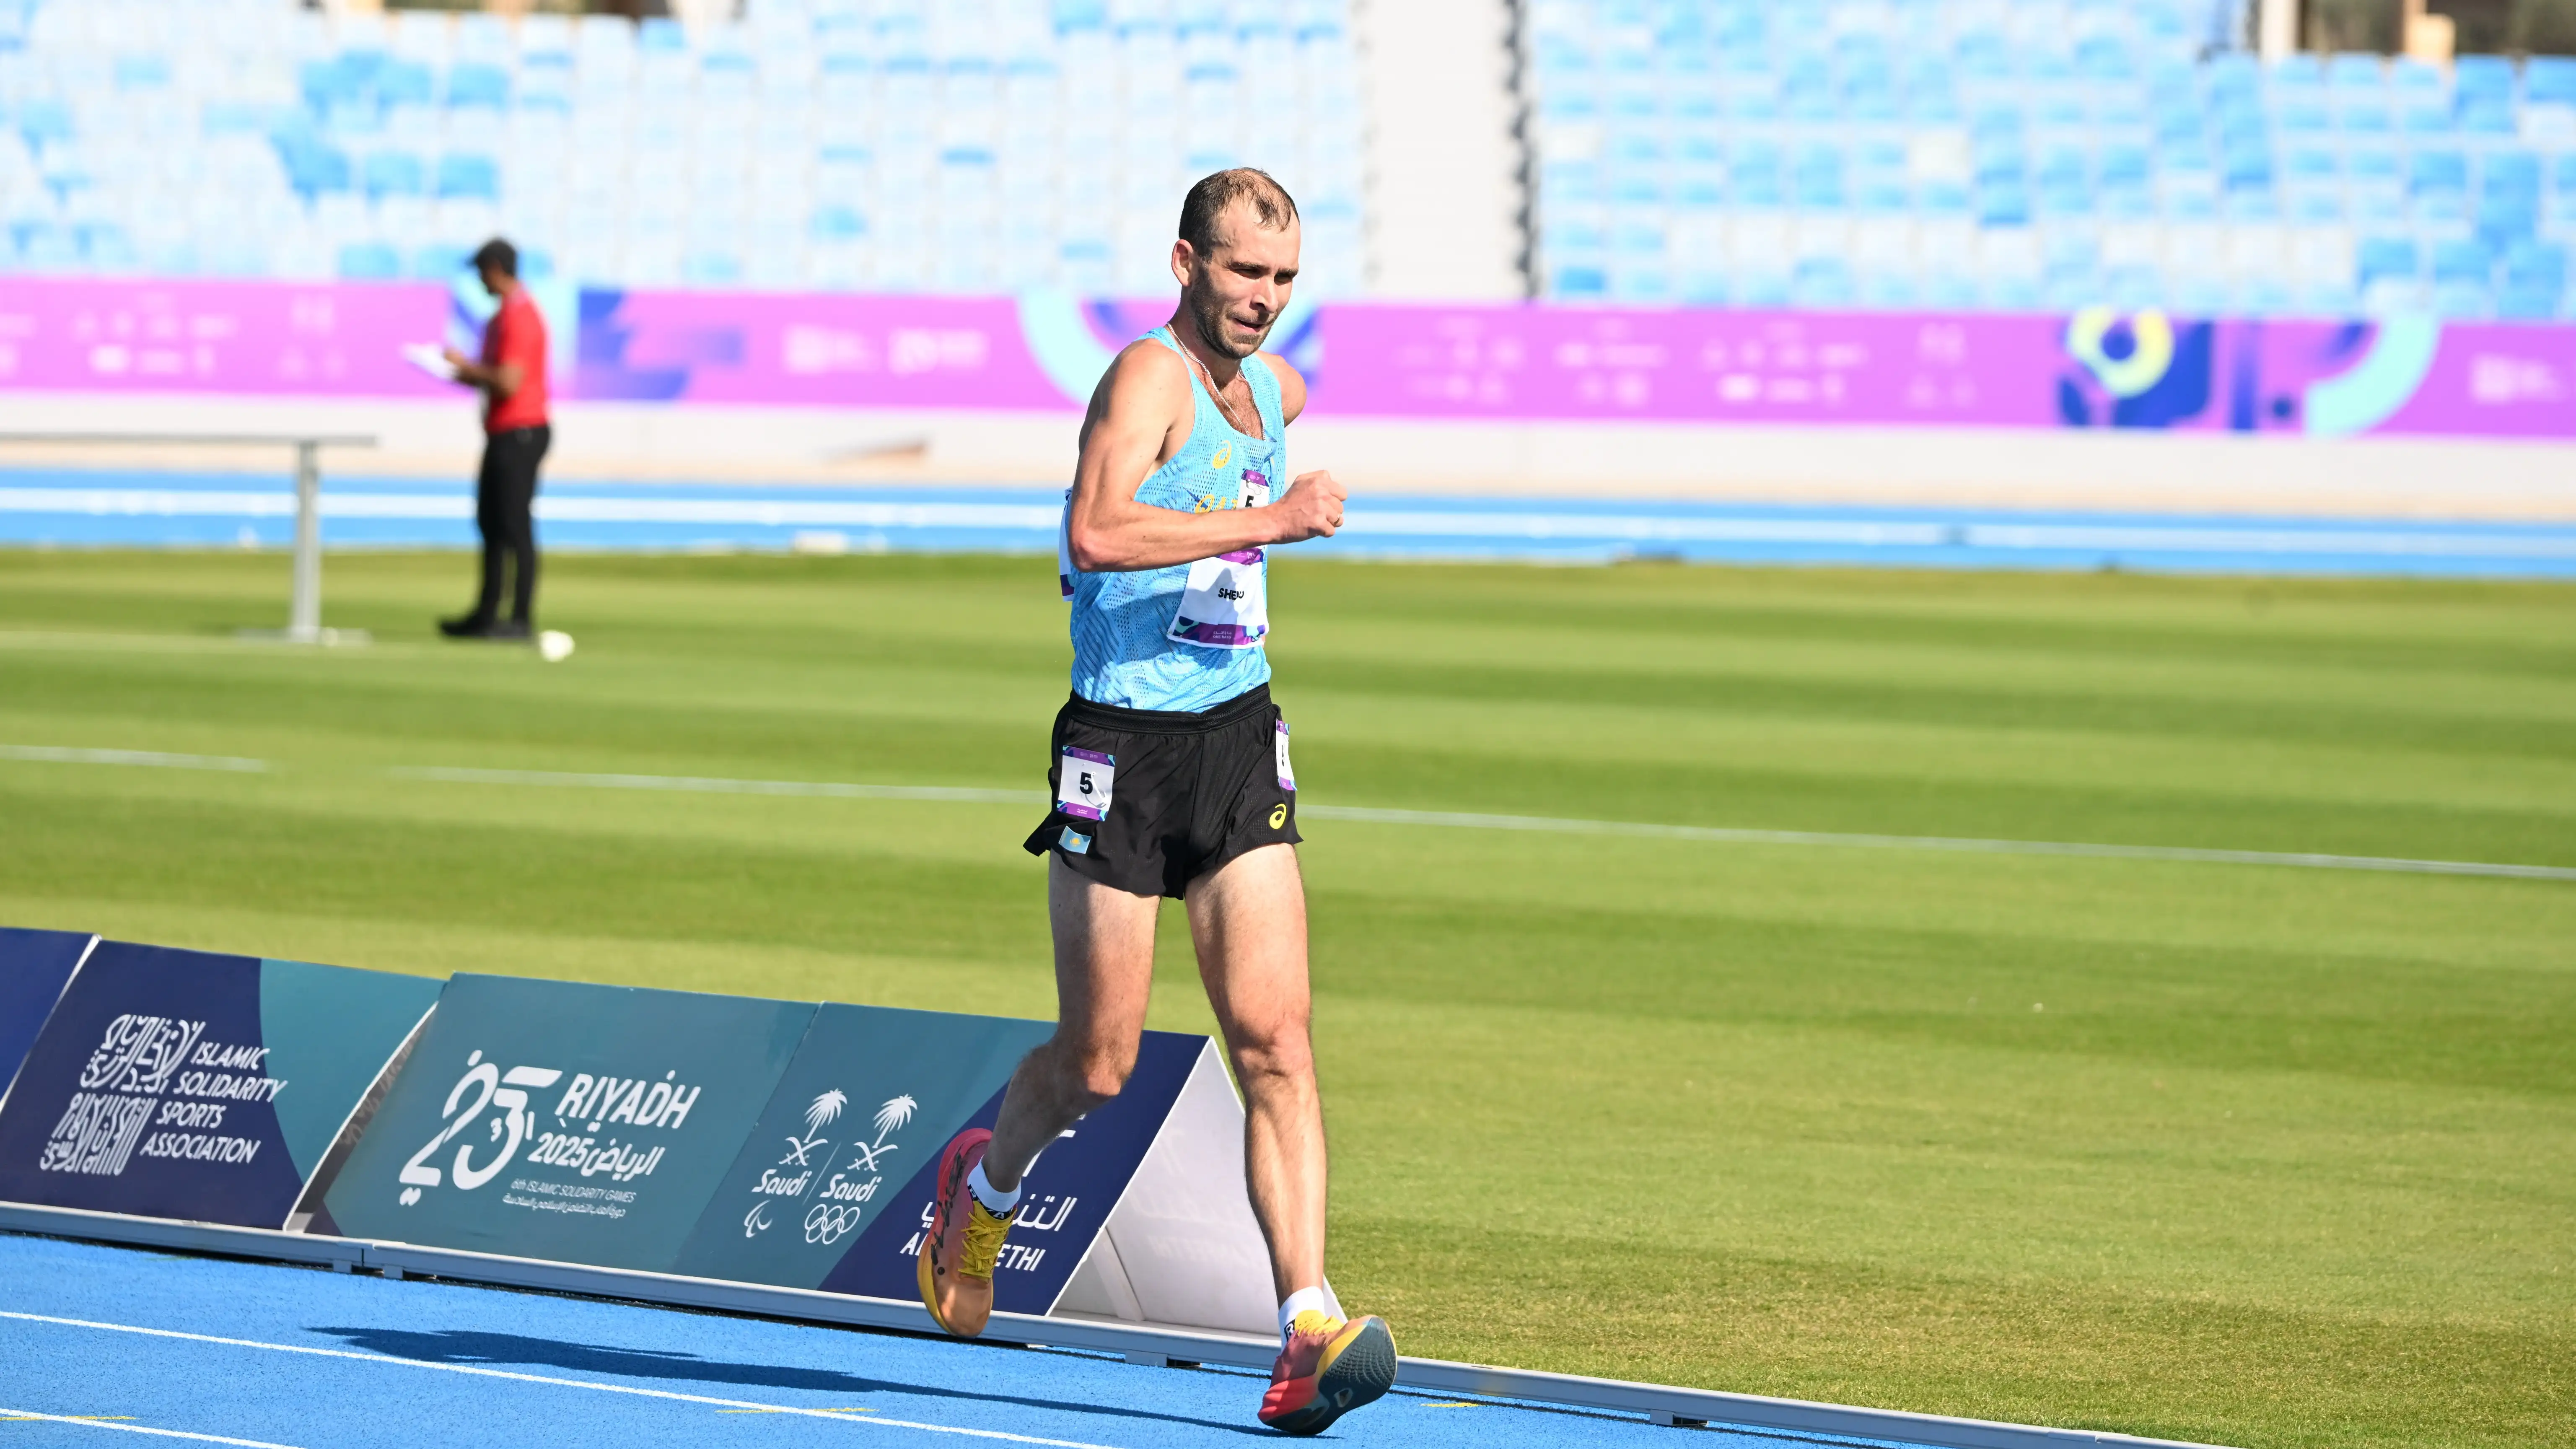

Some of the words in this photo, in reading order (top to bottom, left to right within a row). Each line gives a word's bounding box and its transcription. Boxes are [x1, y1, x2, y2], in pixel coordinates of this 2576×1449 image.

[1080, 772, 1093, 794] 5
[190, 1041, 270, 1070] ISLAMIC
[173, 1071, 288, 1102] SOLIDARITY
[555, 1071, 701, 1130] RIYADH
[155, 1101, 227, 1128] SPORTS
[140, 1131, 261, 1164] ASSOCIATION
[527, 1132, 595, 1168] 2025
[581, 1138, 666, 1182] الرياض
[526, 1180, 560, 1195] ISLAMIC
[560, 1185, 606, 1199] SOLIDARITY
[605, 1190, 637, 1203] GAMES
[752, 1169, 812, 1196] Saudi
[819, 1173, 882, 1202] Saudi
